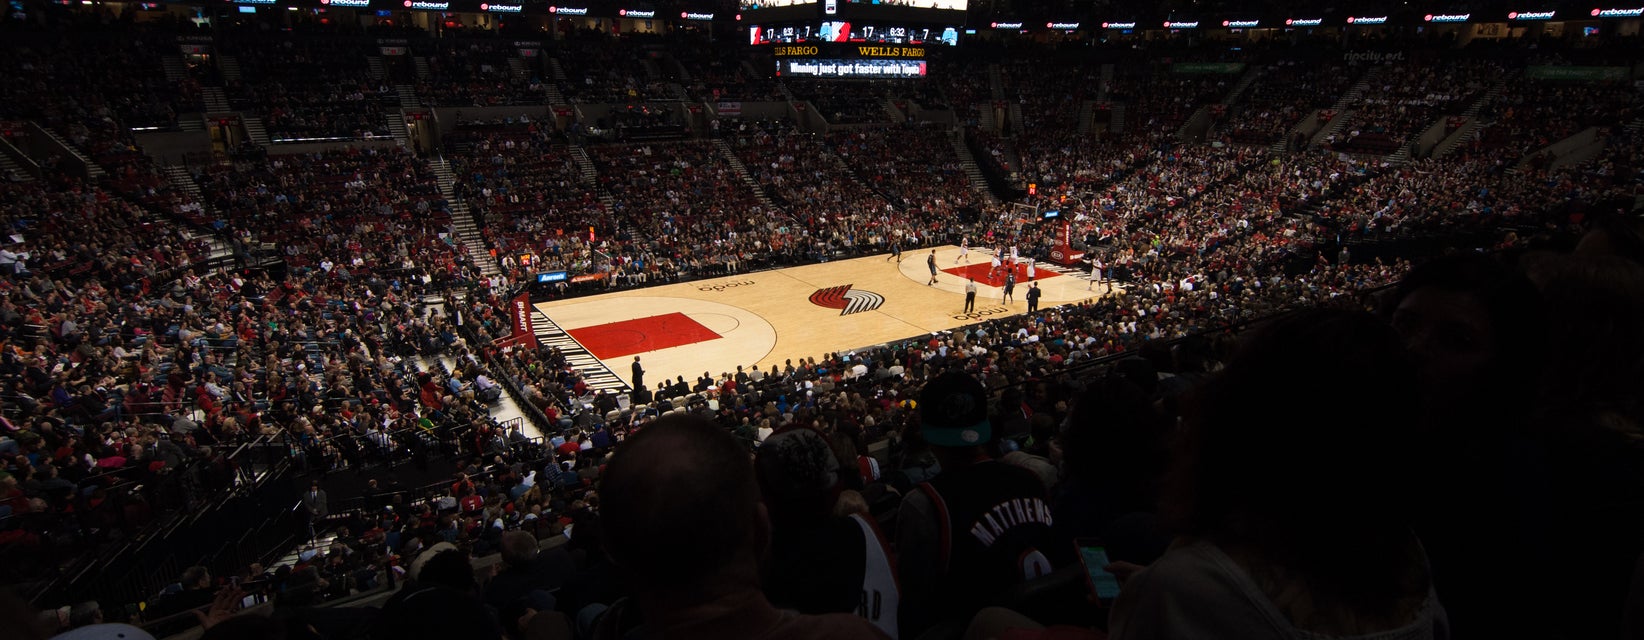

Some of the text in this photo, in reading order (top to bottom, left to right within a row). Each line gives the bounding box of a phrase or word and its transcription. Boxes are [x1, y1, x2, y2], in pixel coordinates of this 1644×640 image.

[1432, 13, 1470, 21] rebound
[1517, 11, 1555, 19] rebound
[1600, 8, 1644, 16] rebound
[767, 28, 774, 39] 17
[805, 26, 810, 37] 7
[862, 26, 929, 40] 17 6:32 7
[787, 46, 818, 55] FARGO
[858, 46, 925, 57] WELLS FARGO
[790, 62, 818, 75] Winning
[818, 63, 836, 75] just
[837, 64, 853, 76] got
[854, 63, 882, 74] faster
[883, 63, 900, 74] with
[517, 301, 528, 332] BI-MART
[969, 498, 1053, 548] MATTHEWS
